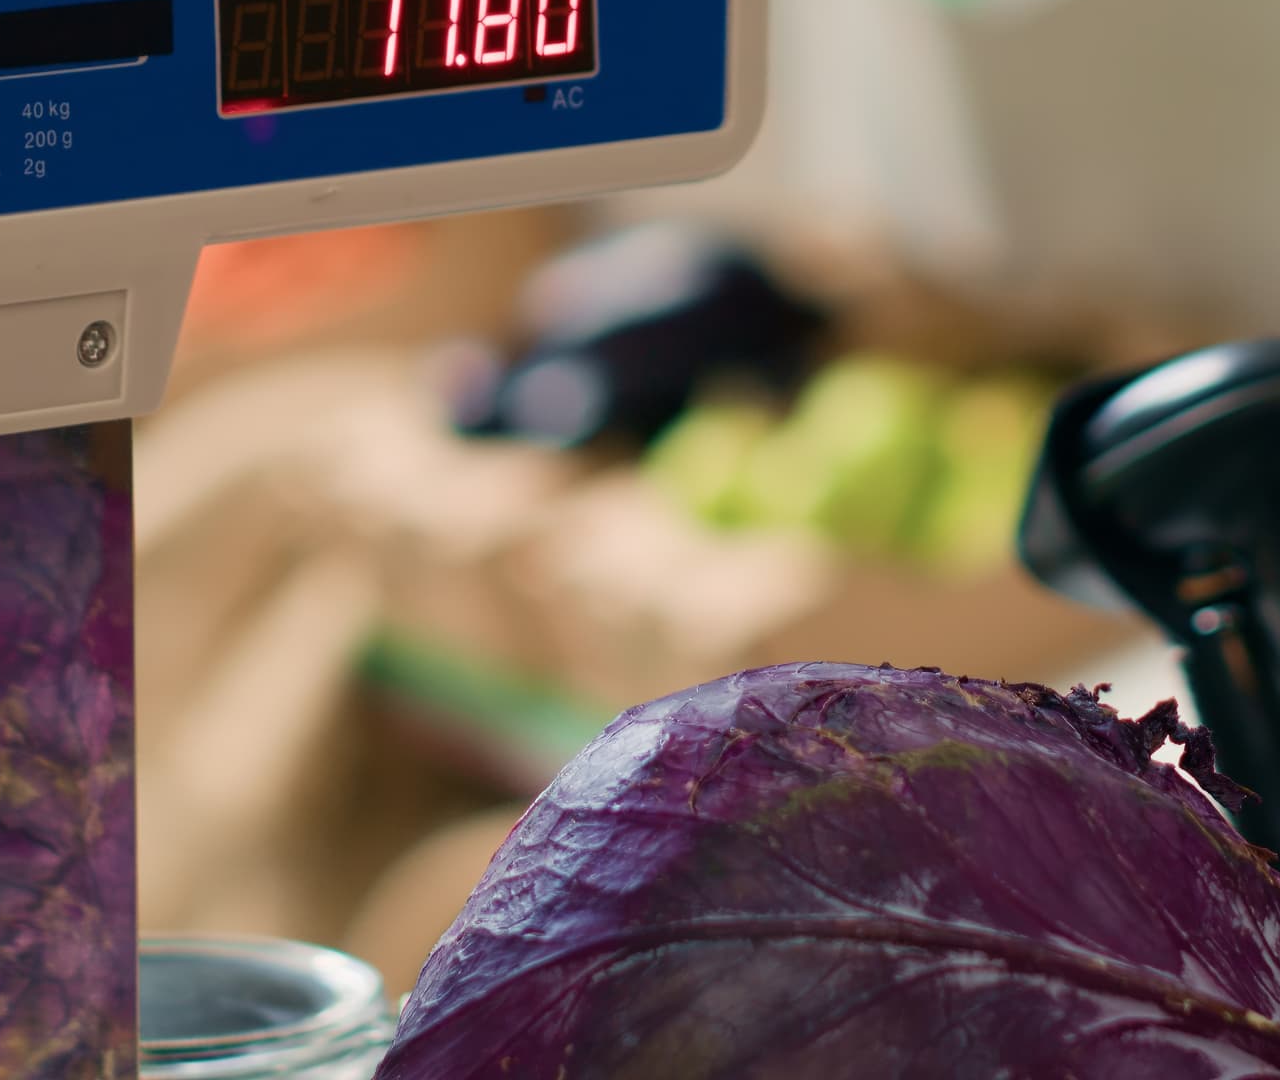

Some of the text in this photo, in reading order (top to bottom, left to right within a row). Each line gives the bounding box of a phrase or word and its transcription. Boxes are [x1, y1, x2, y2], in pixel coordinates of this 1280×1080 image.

[552, 86, 585, 110] AC
[22, 101, 44, 119] 40
[48, 100, 71, 120] kg
[24, 129, 57, 149] 200
[62, 130, 73, 149] g
[23, 158, 46, 178] 2g
